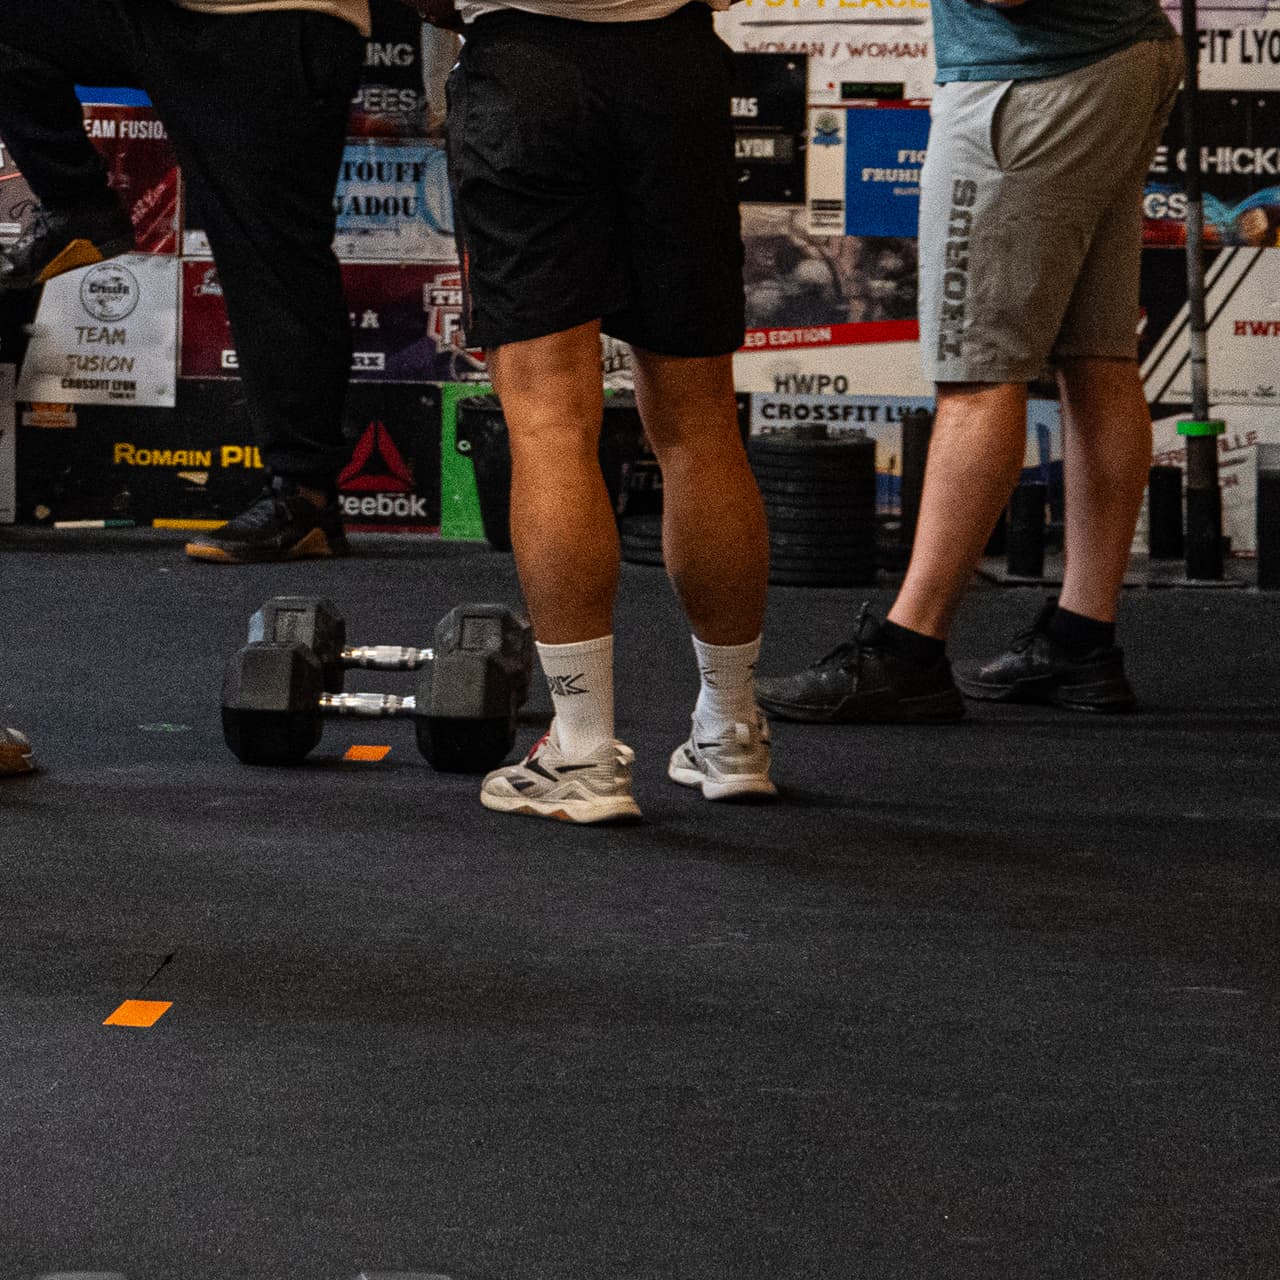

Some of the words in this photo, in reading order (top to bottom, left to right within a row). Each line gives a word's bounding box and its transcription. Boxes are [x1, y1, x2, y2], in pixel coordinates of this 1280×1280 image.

[845, 41, 929, 59] WOMAN
[118, 119, 167, 140] FUSIO
[74, 325, 127, 346] TEAM
[769, 326, 832, 345] EDITION
[66, 354, 136, 374] FUSION
[774, 374, 849, 395] HWPO
[761, 402, 881, 422] CROSSFIT
[113, 443, 212, 468] ROMAIN
[340, 494, 427, 517] eebok
